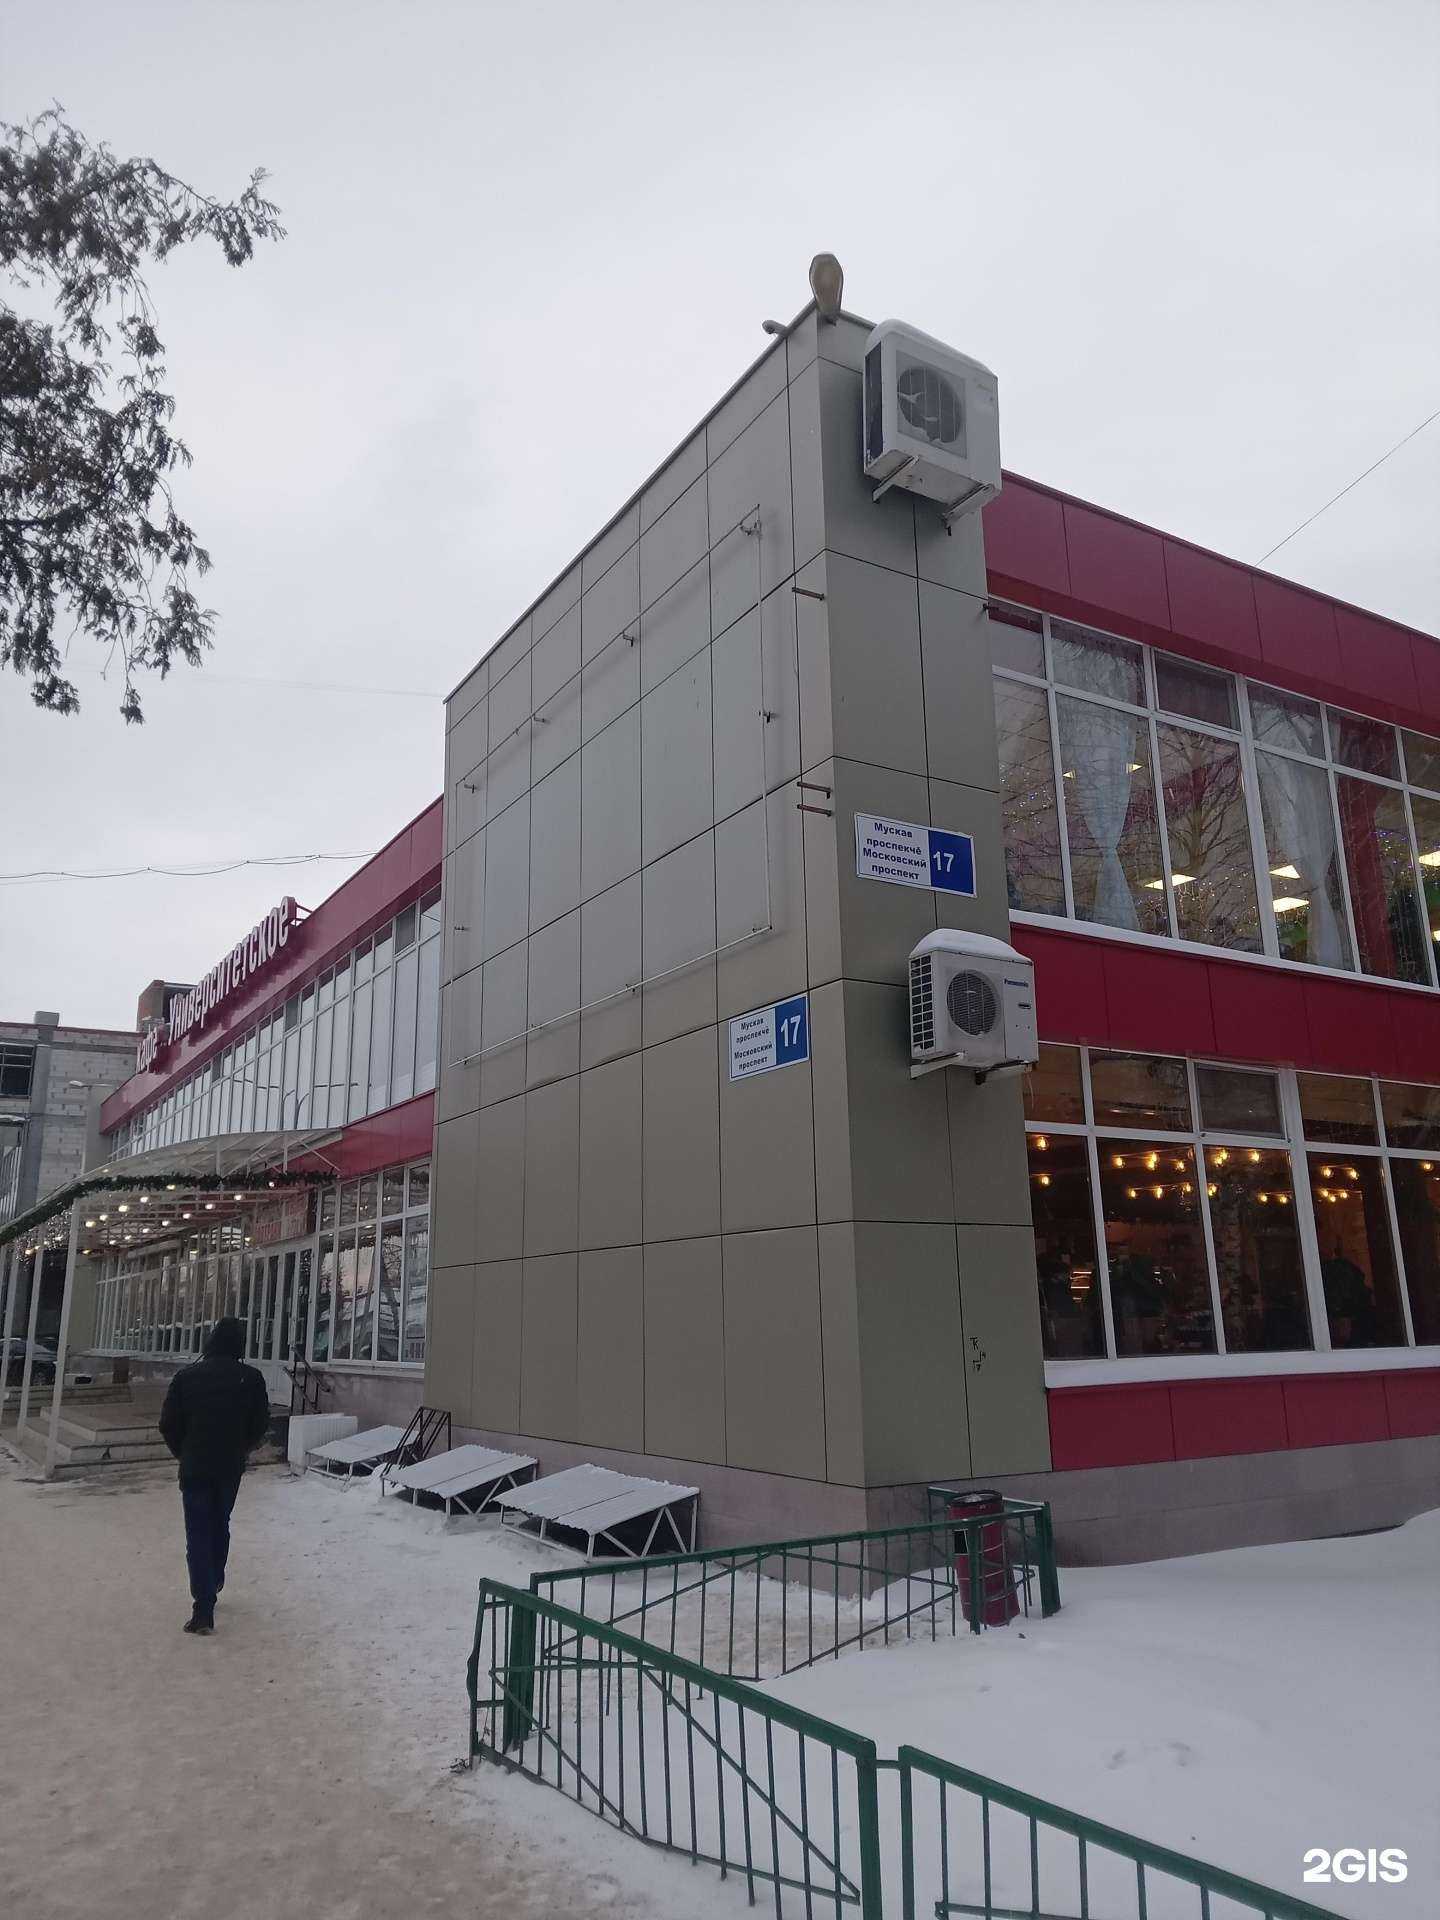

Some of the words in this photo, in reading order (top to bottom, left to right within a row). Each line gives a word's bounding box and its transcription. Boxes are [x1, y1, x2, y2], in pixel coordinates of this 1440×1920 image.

[874, 822, 913, 838] Мускав
[863, 847, 927, 868] Московский
[933, 851, 954, 873] 17
[871, 864, 920, 880] проспект
[740, 1018, 764, 1031] Мускав
[780, 1014, 801, 1047] 17
[734, 1041, 773, 1059] Московский
[738, 1056, 768, 1071] проспект
